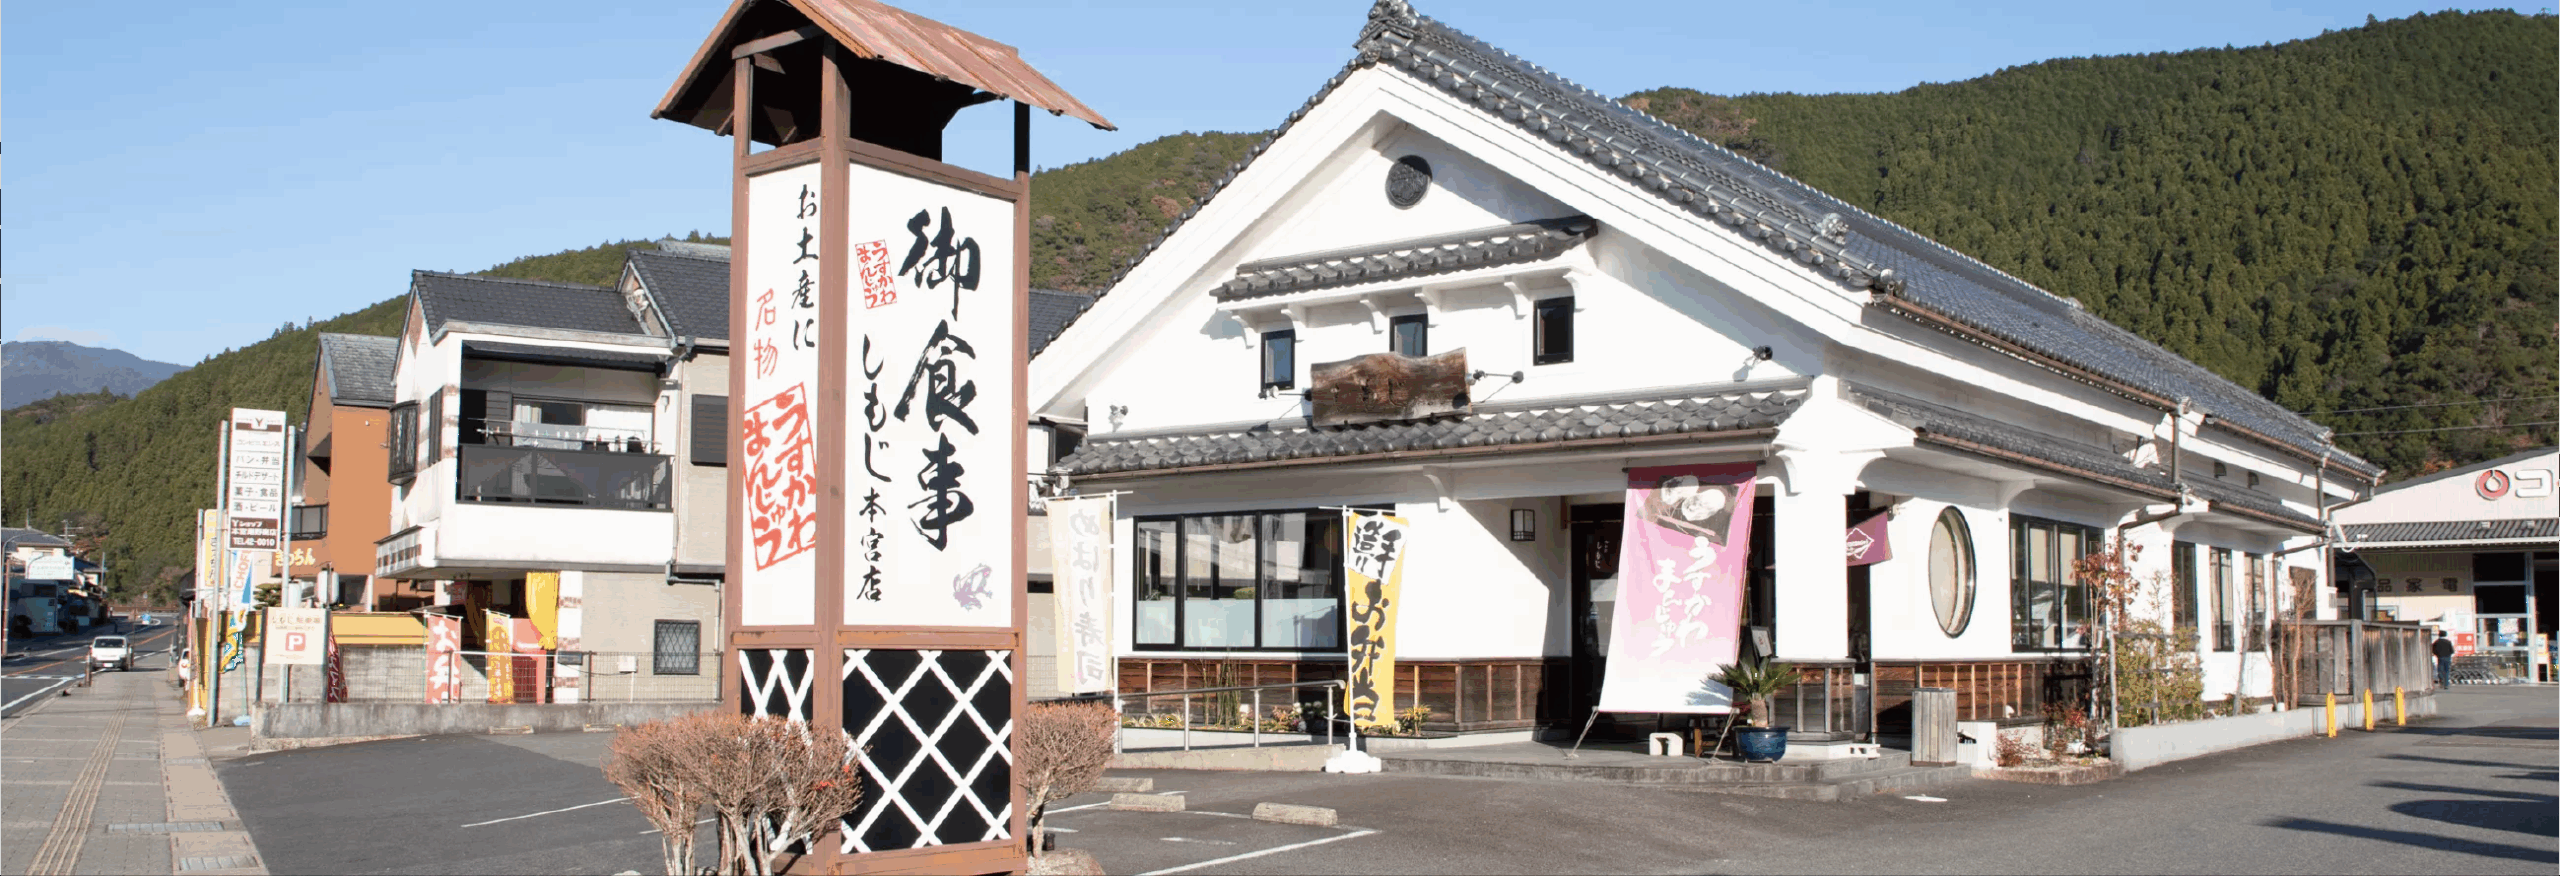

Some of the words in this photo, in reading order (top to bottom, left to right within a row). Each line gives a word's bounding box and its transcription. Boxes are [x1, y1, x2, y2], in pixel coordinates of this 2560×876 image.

[791, 183, 819, 349] お土産に
[857, 245, 881, 309] まんじゅう
[871, 242, 896, 306] うすかわ
[753, 288, 779, 379] 名物
[894, 205, 981, 552] 御食事
[743, 408, 787, 571] まんじゅう
[773, 388, 817, 551] うすかわ
[857, 332, 892, 603] しもじ本宮店
[2514, 468, 2558, 499] コ
[288, 635, 303, 651] P
[1651, 557, 1683, 657] まんじゅう
[1676, 535, 1717, 648] うすかわ
[429, 619, 461, 703] お弁
[1351, 579, 1391, 722] お弁当
